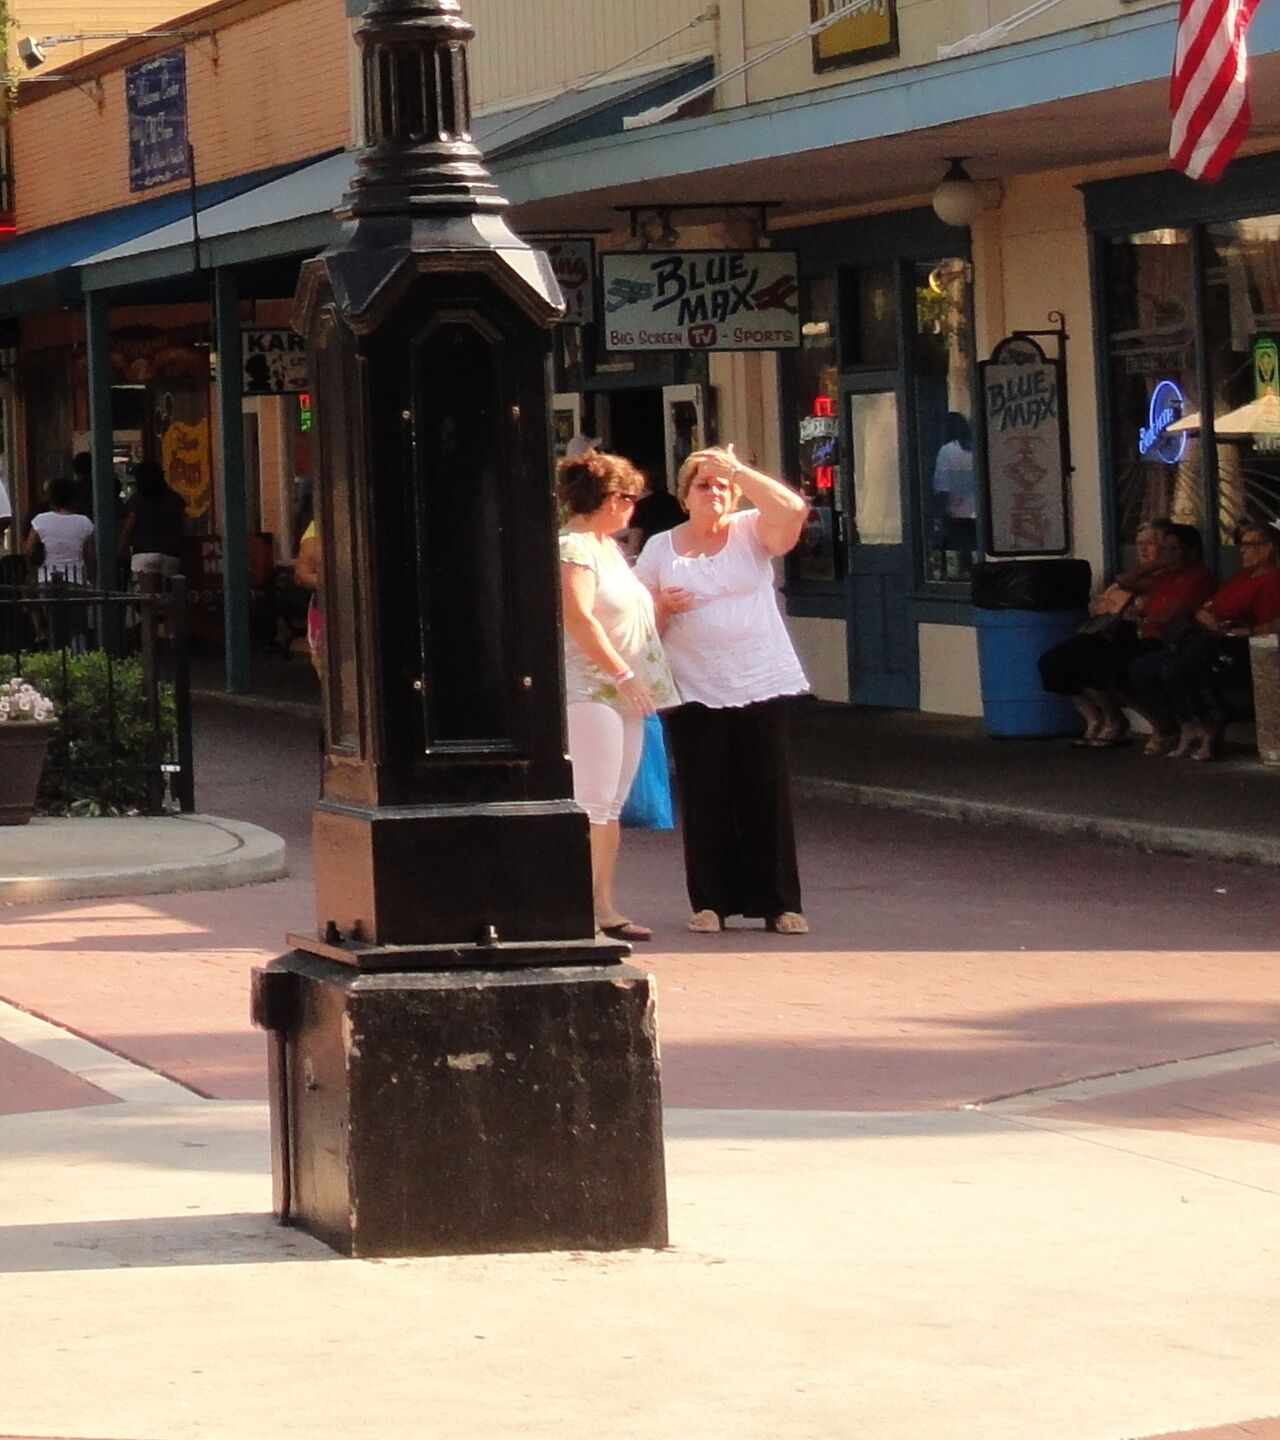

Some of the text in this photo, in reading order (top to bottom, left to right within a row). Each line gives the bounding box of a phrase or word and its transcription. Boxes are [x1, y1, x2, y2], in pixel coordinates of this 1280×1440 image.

[650, 254, 748, 312] BLUE
[677, 267, 760, 327] MAX
[248, 334, 306, 353] KAR
[609, 330, 635, 347] BIG
[690, 328, 715, 345] TV
[987, 370, 1049, 417] BLUE
[998, 384, 1056, 432] MAX
